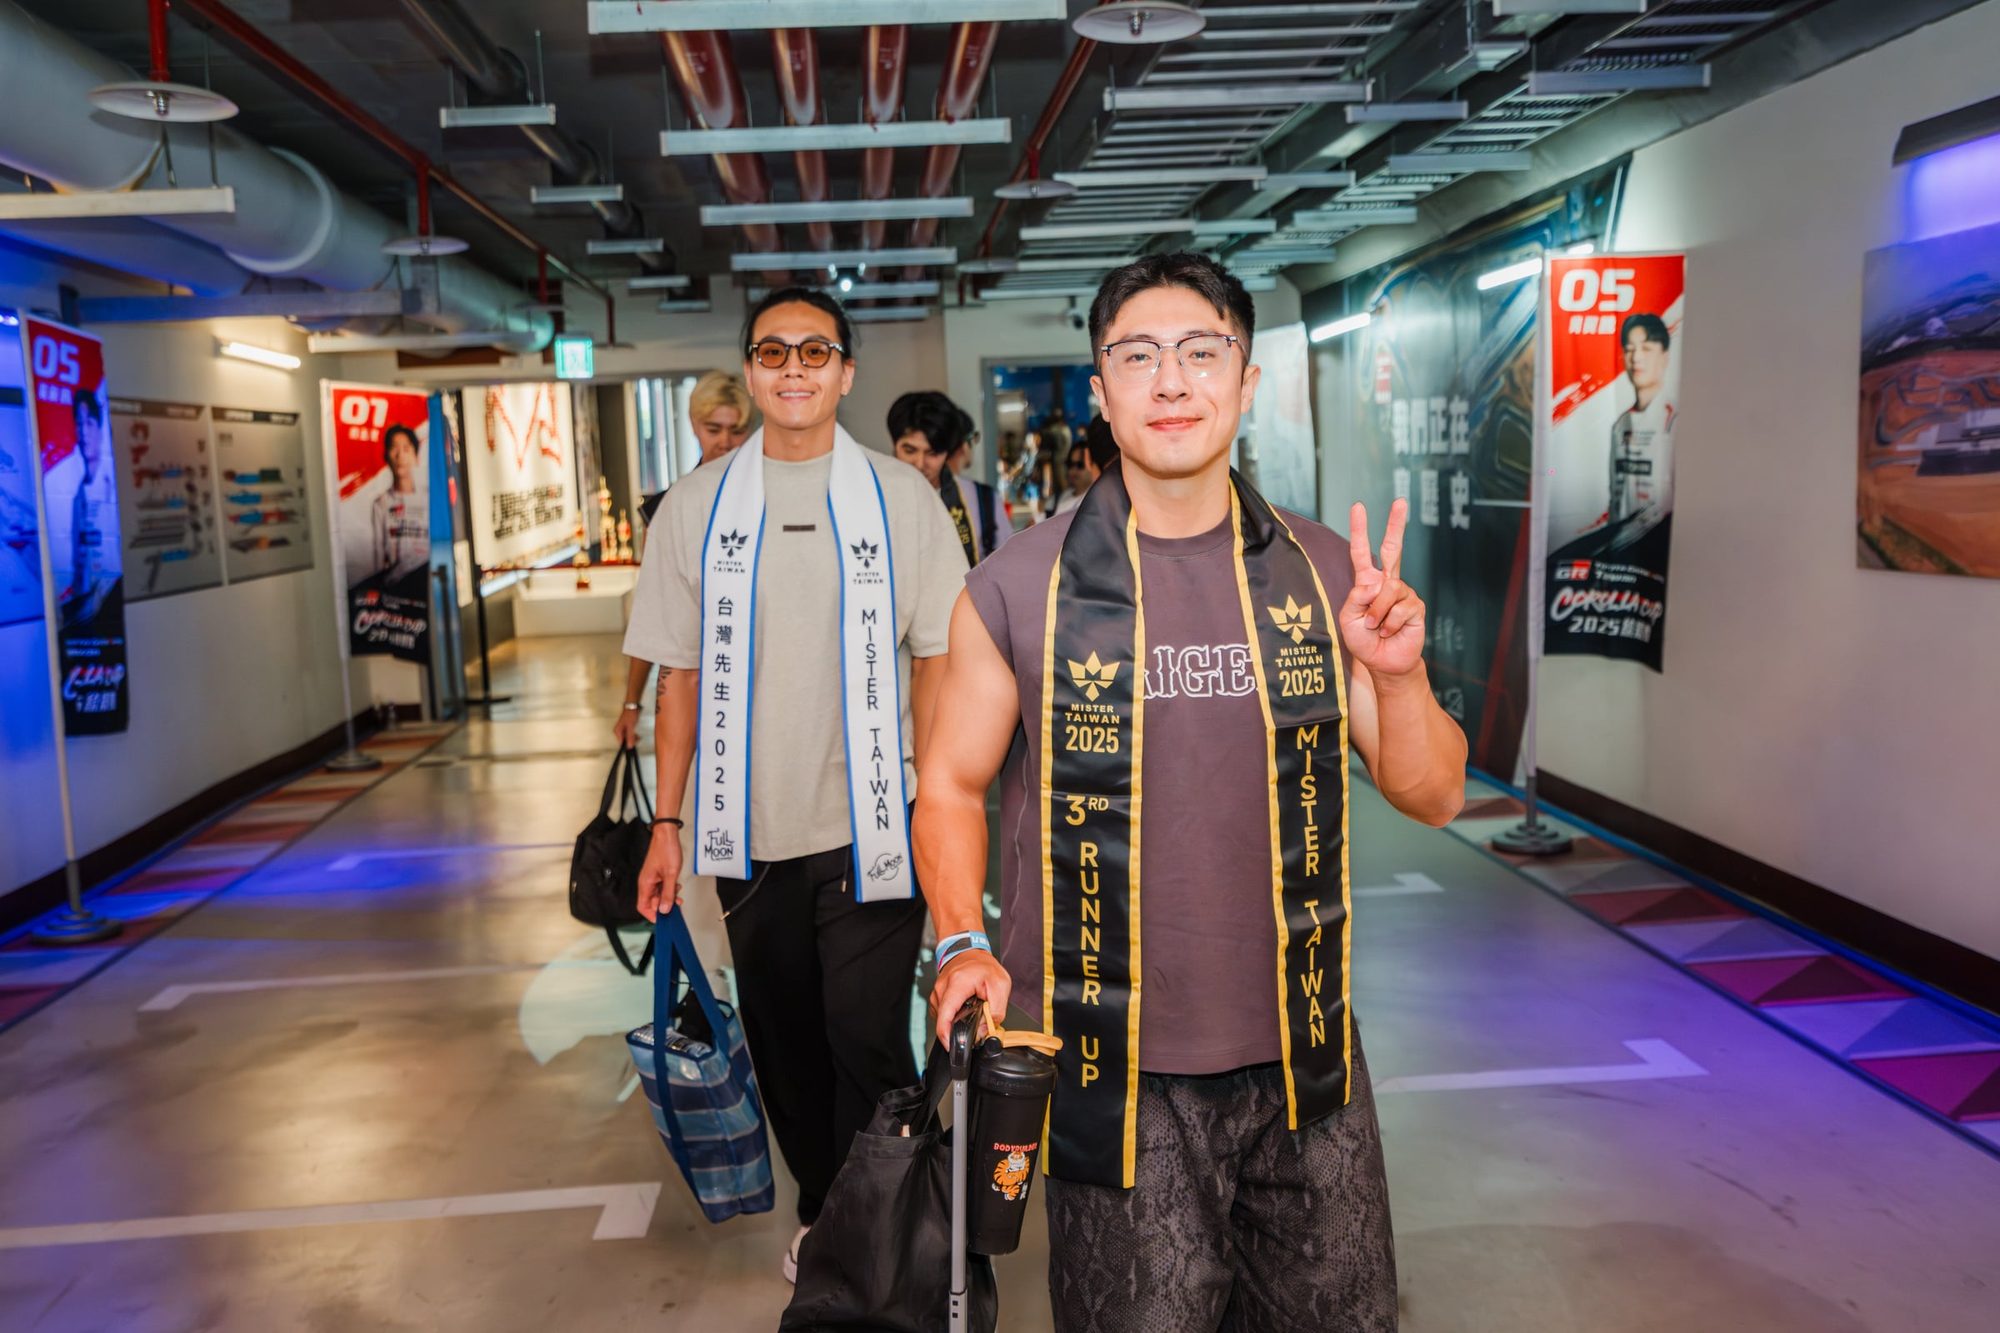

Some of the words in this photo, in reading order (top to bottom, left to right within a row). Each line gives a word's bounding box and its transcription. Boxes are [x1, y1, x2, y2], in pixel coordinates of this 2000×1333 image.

[1558, 268, 1635, 312] 05
[34, 335, 79, 385] 05
[340, 395, 388, 428] 01
[861, 609, 879, 710] MISTER
[1144, 643, 1260, 699] IGE
[1275, 655, 1323, 667] TAIWAN
[1280, 645, 1317, 656] MISTER
[1279, 668, 1325, 697] 2025
[1065, 712, 1120, 724] TAIWAN
[1071, 703, 1114, 713] MISTER
[1065, 725, 1119, 754] 2025
[869, 728, 890, 831] TAIWAN
[1296, 725, 1320, 877] MISTER
[1080, 842, 1100, 1006] RUNNER
[1300, 901, 1326, 1048] TAIWAN
[1081, 1035, 1099, 1088] UP
